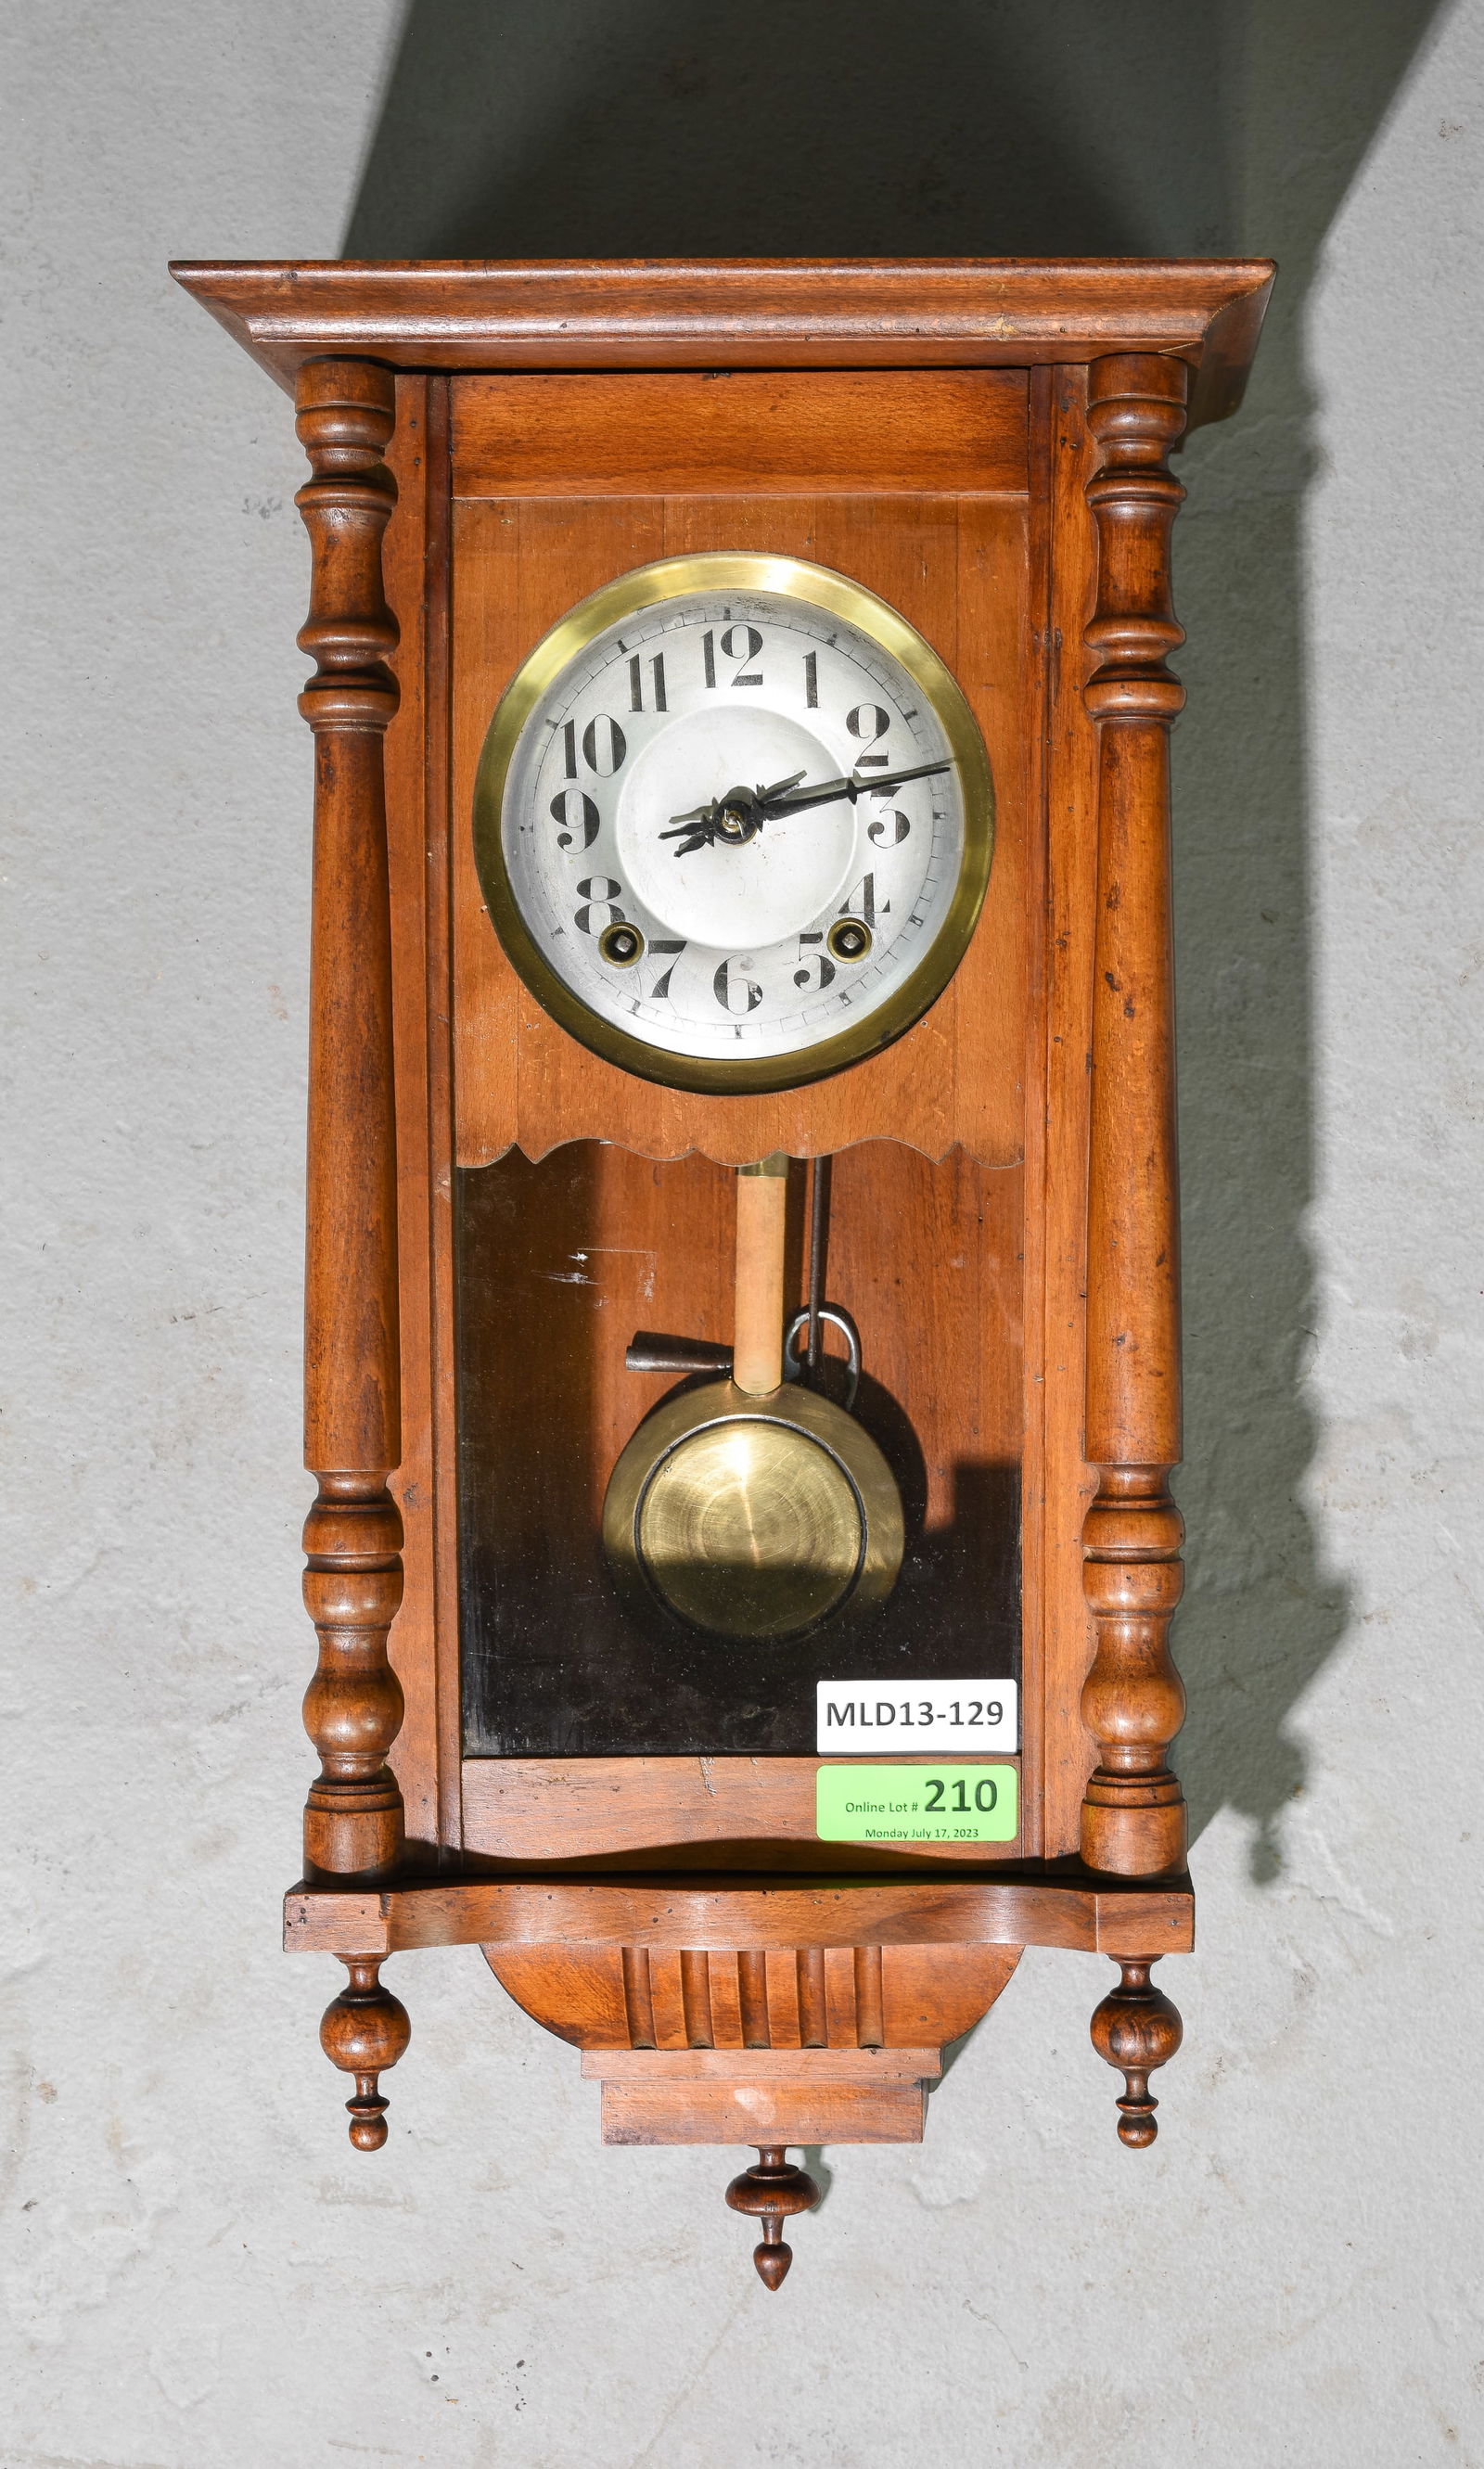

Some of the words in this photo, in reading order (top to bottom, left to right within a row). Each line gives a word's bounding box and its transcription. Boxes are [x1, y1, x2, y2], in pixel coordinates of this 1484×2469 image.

[626, 652, 670, 712] 11
[702, 624, 763, 689] 12
[802, 649, 821, 709] 1
[560, 713, 627, 779] 10
[845, 703, 889, 767] 2
[549, 788, 600, 854] 9
[867, 785, 911, 849] 3
[573, 876, 625, 938] 8
[838, 872, 890, 929] 4
[647, 940, 687, 999] 7
[712, 953, 763, 1016] 6
[793, 931, 836, 992] 5
[826, 1701, 1004, 1727] MLD13-129
[845, 1801, 886, 1813] Online
[889, 1801, 908, 1813] Lot
[911, 1802, 919, 1812] #
[925, 1779, 998, 1812] 210
[865, 1828, 908, 1840] Monday
[911, 1828, 932, 1840] July
[935, 1828, 951, 1839] 17,
[953, 1828, 979, 1838] 2023
